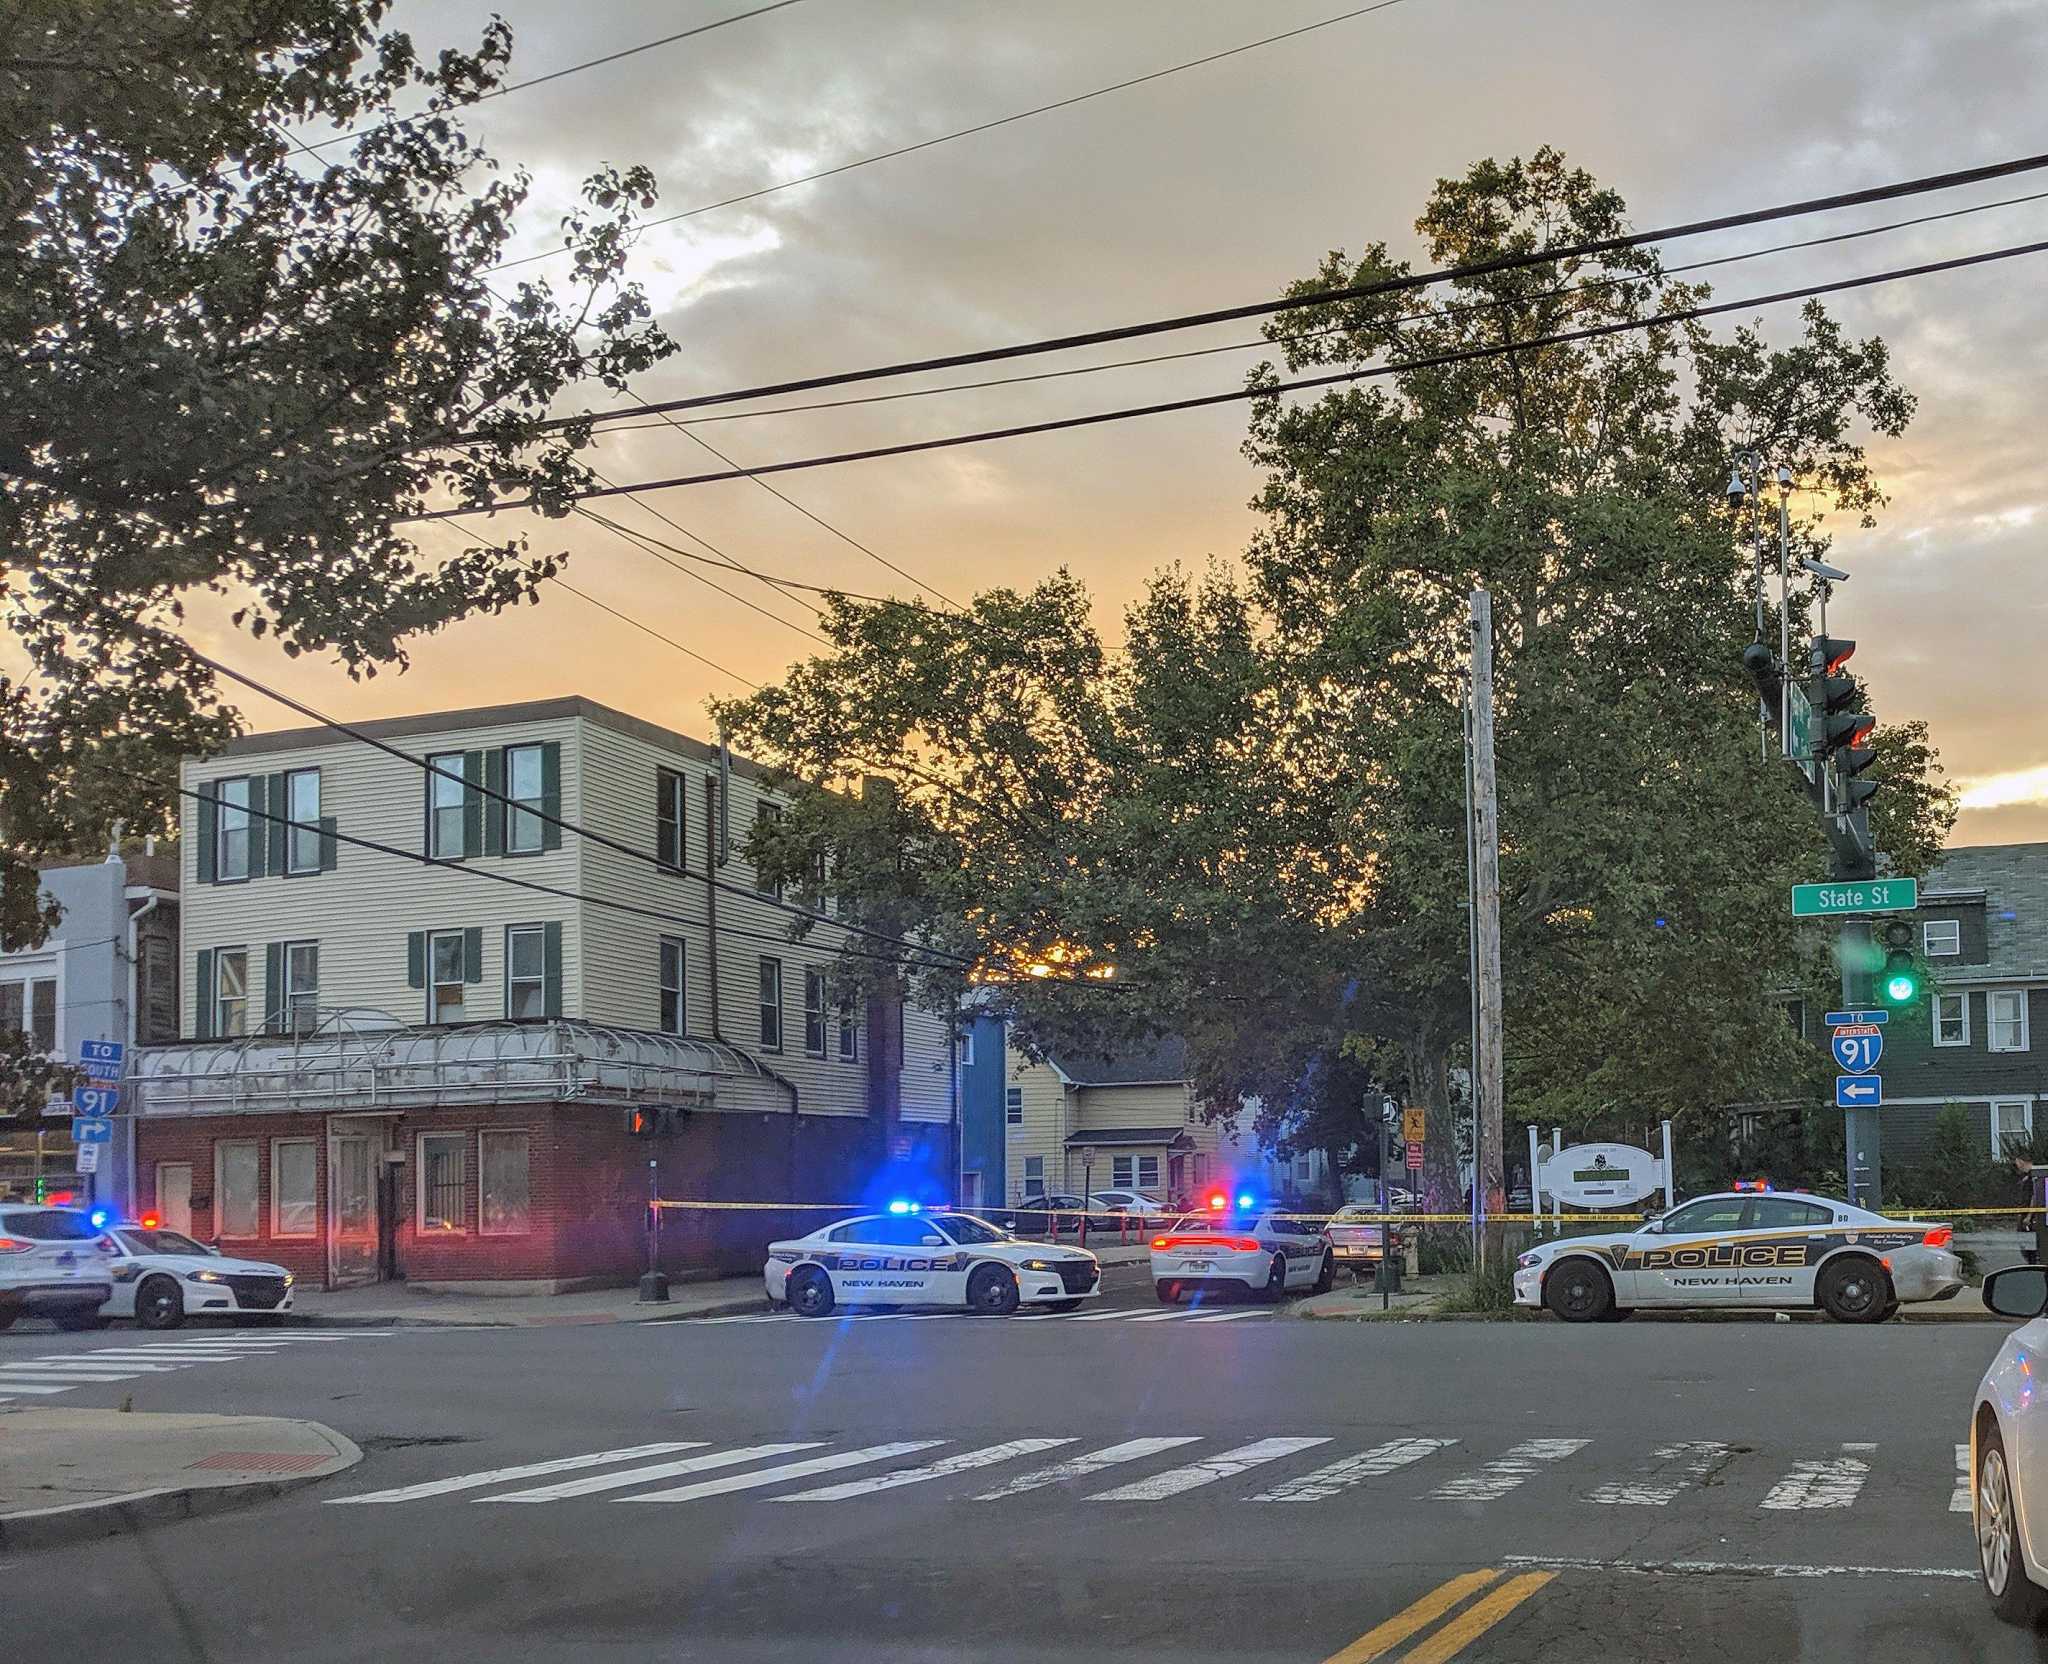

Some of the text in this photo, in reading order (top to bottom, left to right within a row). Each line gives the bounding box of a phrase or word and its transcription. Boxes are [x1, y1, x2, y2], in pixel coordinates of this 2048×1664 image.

[1818, 887, 1890, 908] State St
[1850, 1013, 1864, 1023] TO
[1839, 1027, 1875, 1036] INTERSTATE
[91, 1044, 112, 1057] TO
[1840, 1038, 1870, 1065] 91
[80, 1063, 119, 1078] SOUTH
[82, 1090, 107, 1113] 91
[1640, 1245, 1808, 1270] POLICE
[838, 1258, 949, 1272] POLICE
[878, 1280, 924, 1288] HAVEN
[1673, 1277, 1793, 1286] NEW HAVEN
